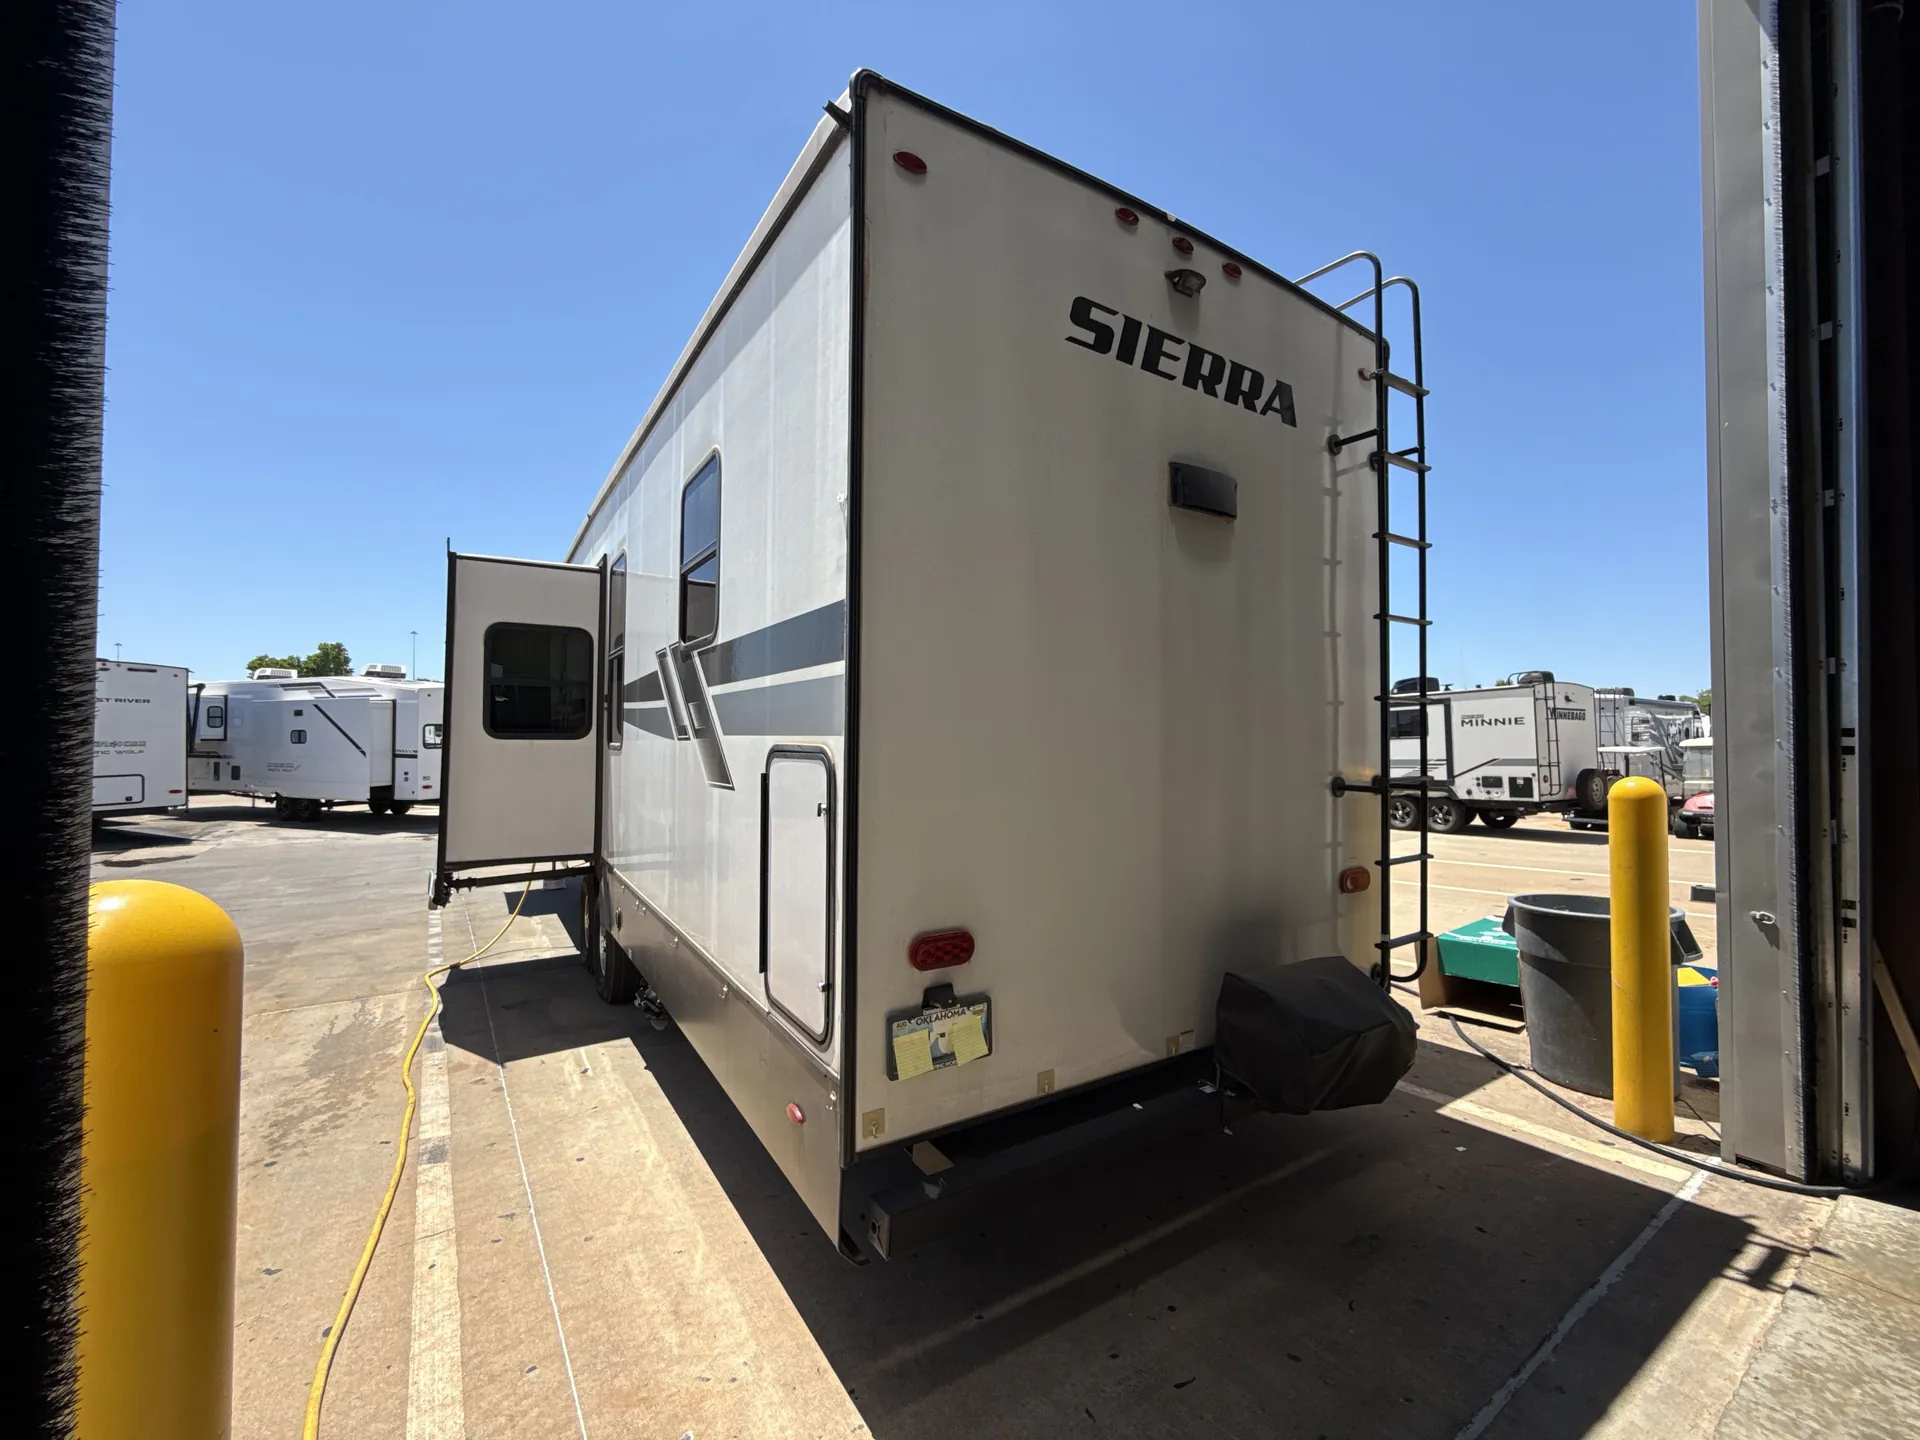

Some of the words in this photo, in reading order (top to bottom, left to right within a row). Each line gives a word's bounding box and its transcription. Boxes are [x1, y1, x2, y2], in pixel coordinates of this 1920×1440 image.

[1065, 296, 1297, 428] SIERRA
[1461, 716, 1525, 727] MINNIE
[916, 1008, 966, 1025] OKLAHOMA
